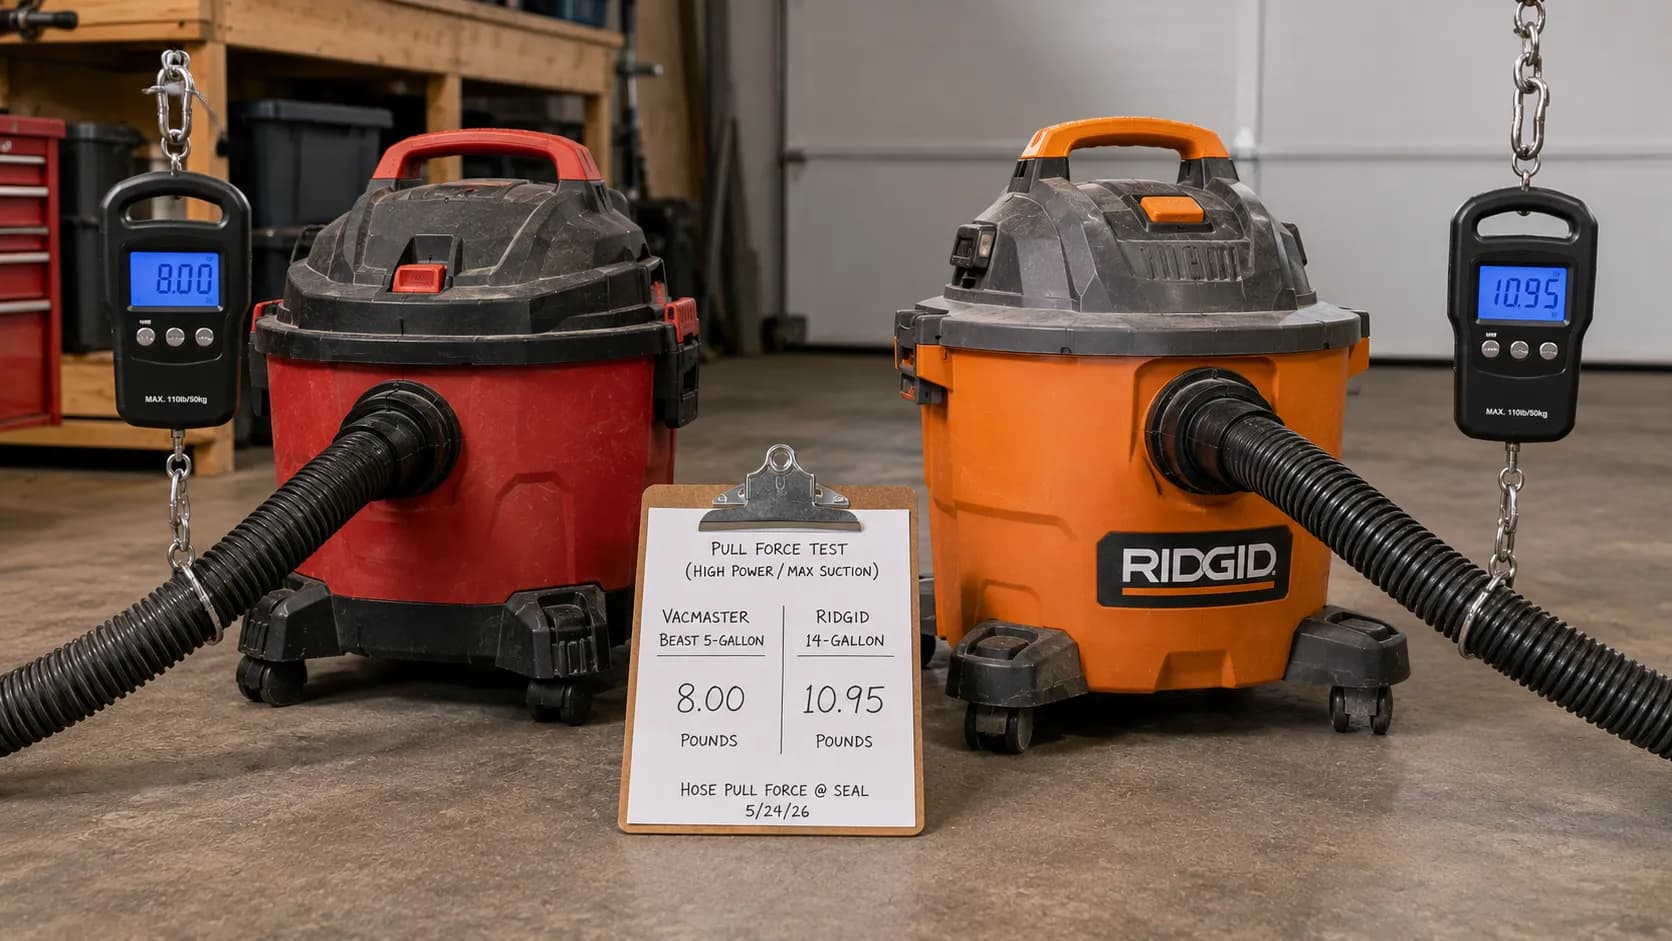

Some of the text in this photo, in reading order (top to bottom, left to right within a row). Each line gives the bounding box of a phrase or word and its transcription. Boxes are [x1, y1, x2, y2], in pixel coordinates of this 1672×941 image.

[156, 264, 212, 294] 8.00
[1494, 278, 1558, 308] 10.95
[167, 396, 207, 404] 110lb/50kg
[1508, 409, 1547, 418] 110lb/50kg
[712, 542, 848, 555] PULL FORCE TEST
[1122, 543, 1276, 582] RIDGID
[686, 562, 724, 581] (HIGH
[820, 562, 878, 580] SUCTION)
[663, 609, 749, 623] VACMASTER
[817, 609, 869, 623] RIDGID
[660, 633, 764, 646] BEAST 5-GALLON
[807, 634, 884, 647] 14-GALLON
[678, 683, 744, 713] 8.00
[804, 685, 884, 713] 10.95
[681, 734, 737, 747] POUNDS
[816, 734, 872, 748] POUNDS
[681, 782, 868, 798] HOSE PULL FORCE @ SEAL
[746, 803, 809, 819] 5/24/26
